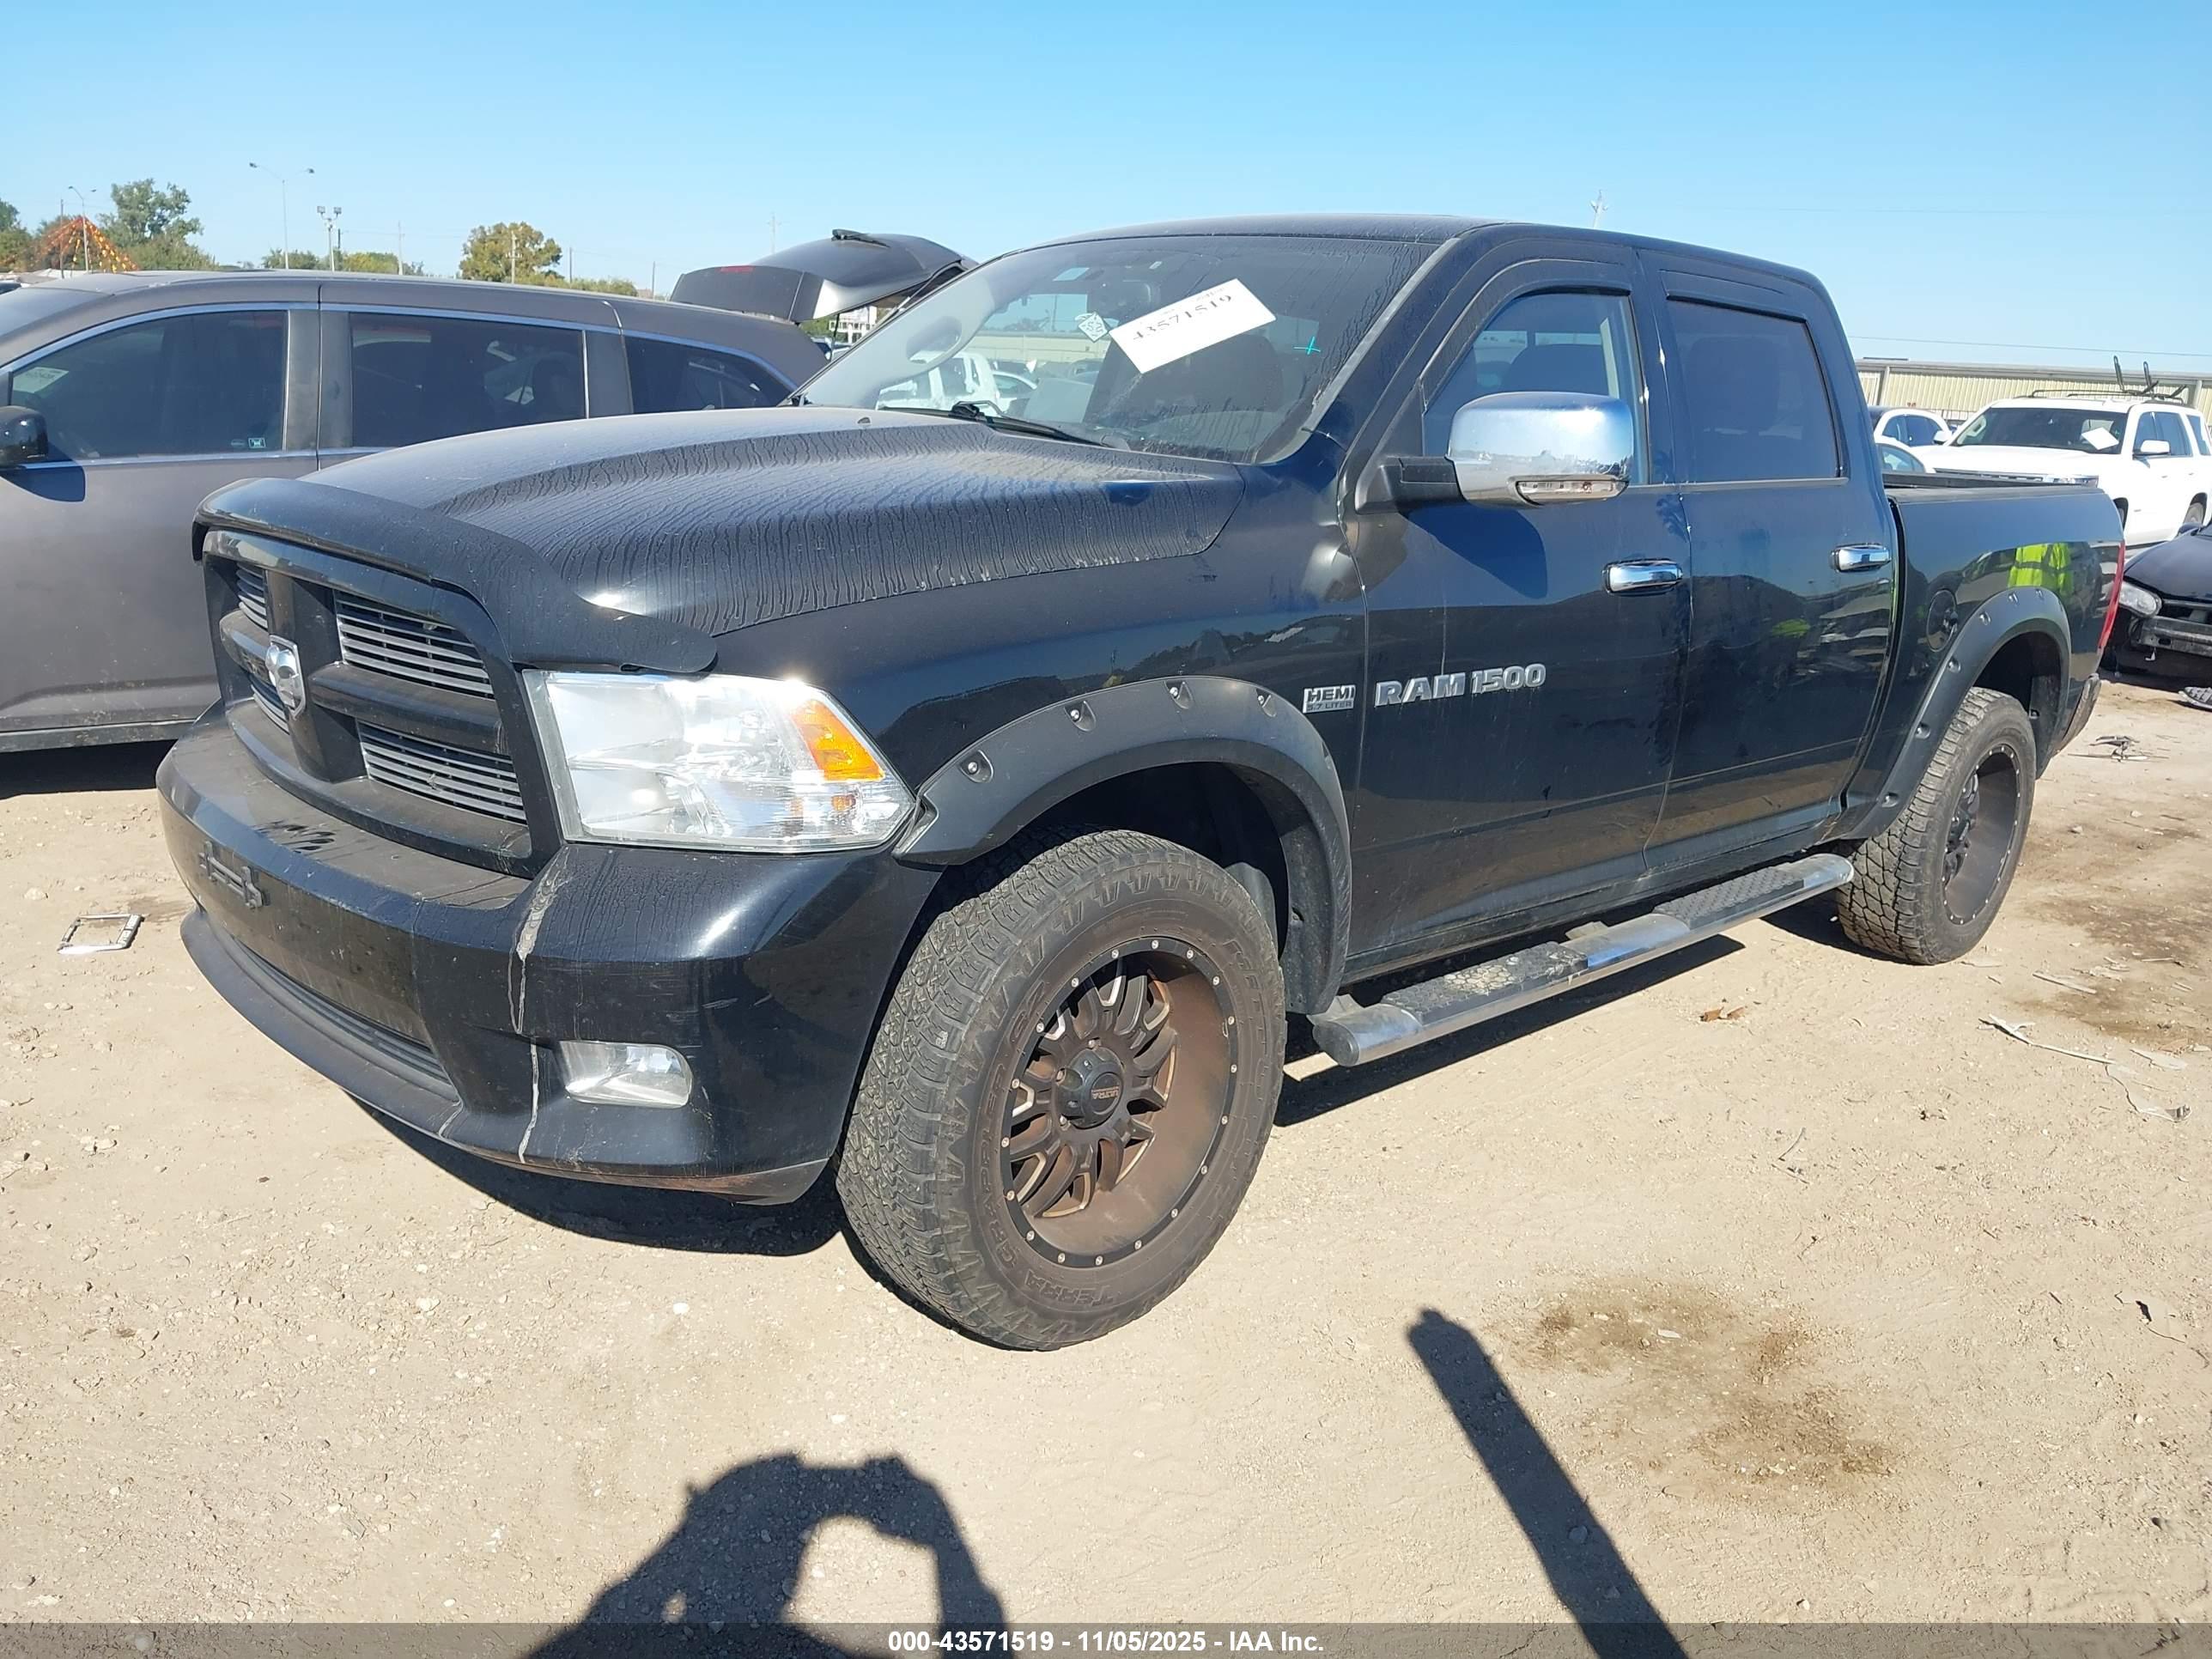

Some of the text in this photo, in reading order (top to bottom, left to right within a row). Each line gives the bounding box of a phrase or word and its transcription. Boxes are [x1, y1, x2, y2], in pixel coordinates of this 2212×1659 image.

[1305, 685, 1356, 702] HEMI
[1374, 663, 1547, 708] RAM 1500
